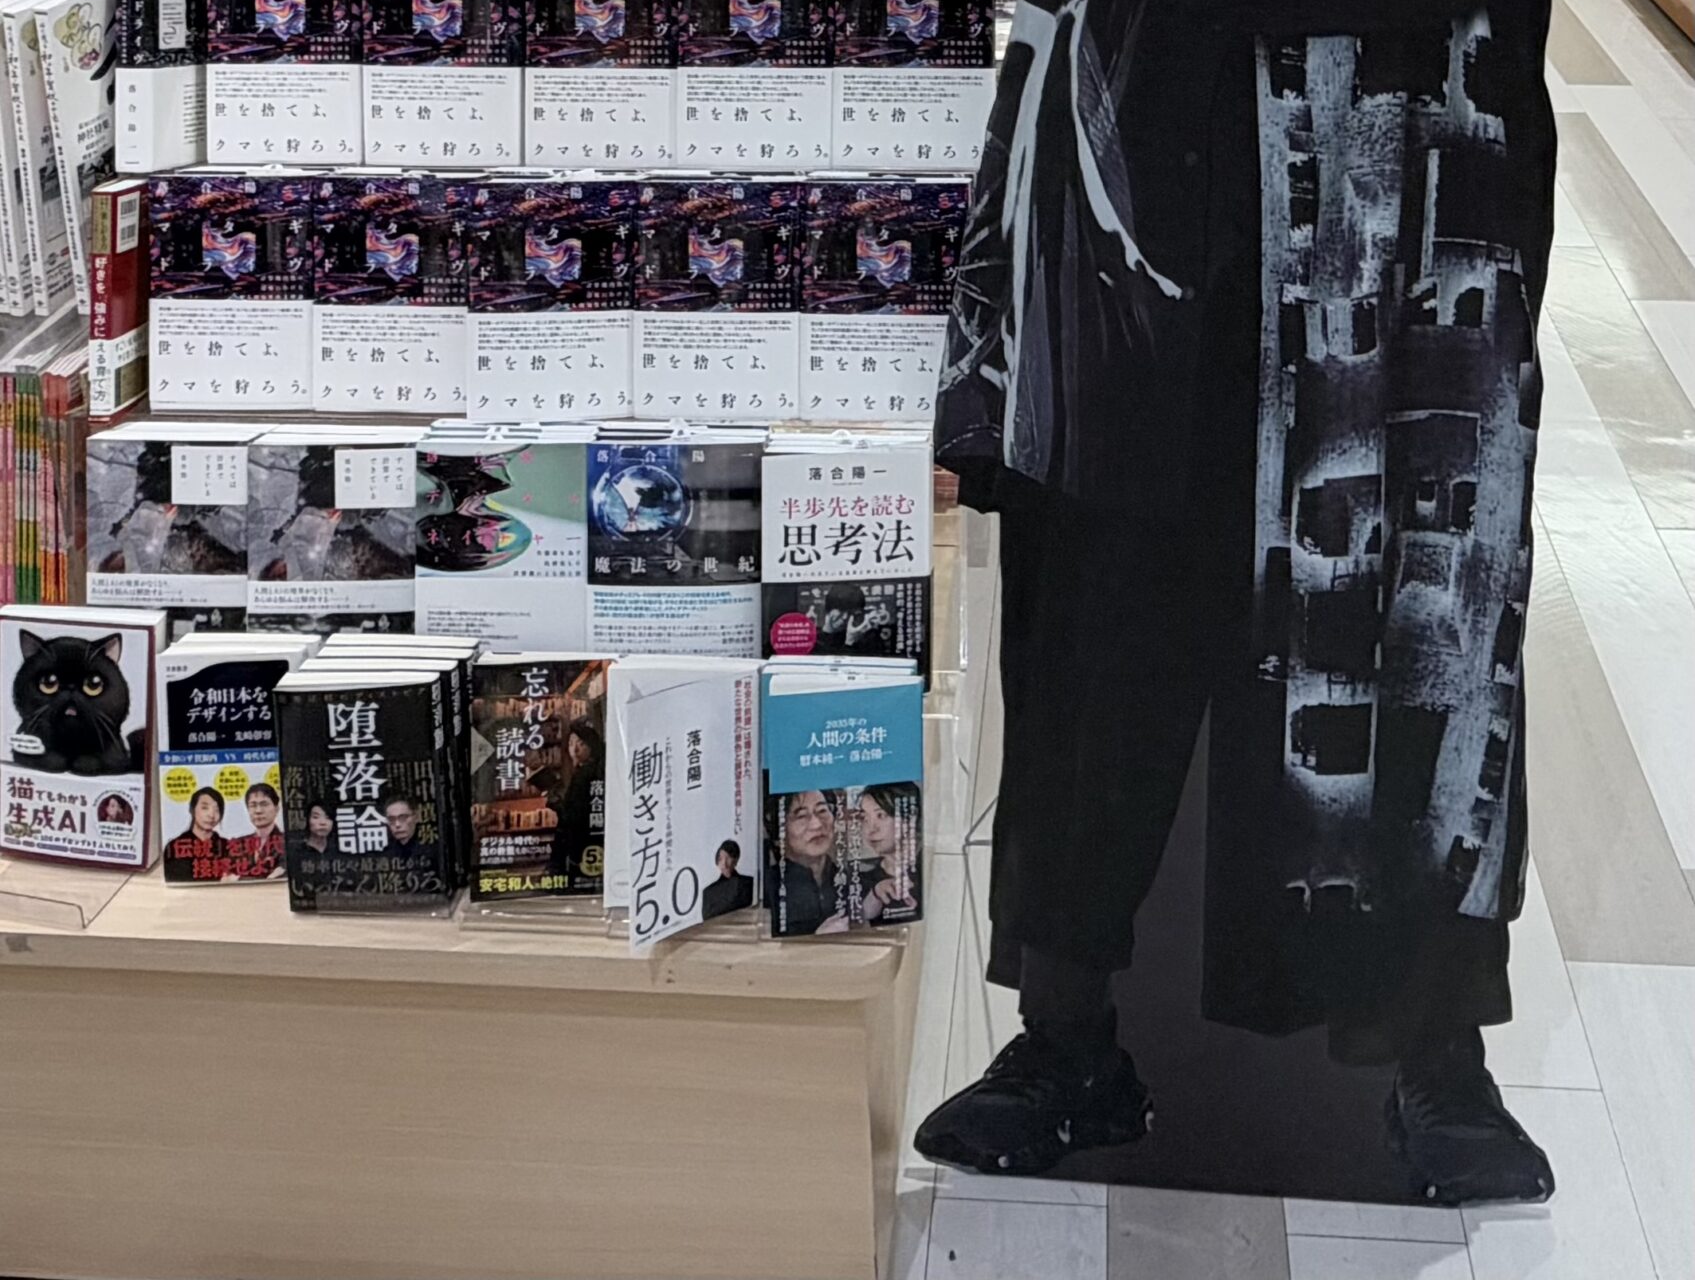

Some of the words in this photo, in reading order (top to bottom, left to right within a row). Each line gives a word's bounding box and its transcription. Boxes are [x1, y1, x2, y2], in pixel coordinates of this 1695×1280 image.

[808, 465, 887, 481] 落合陽一
[780, 493, 915, 520] 半歩先を読む
[778, 519, 916, 567] 思考法
[594, 556, 755, 574] 魔法の世紀
[190, 686, 268, 707] 令和日本を
[521, 666, 550, 751] 忘れる
[187, 704, 272, 723] デザインする
[805, 726, 888, 749] 人間の条件
[495, 727, 526, 791] 読書
[686, 728, 702, 791] 落合陽一
[7, 776, 88, 808] 猫でもわかる
[327, 700, 390, 855] 堕落論
[7, 802, 87, 835] 生成AI
